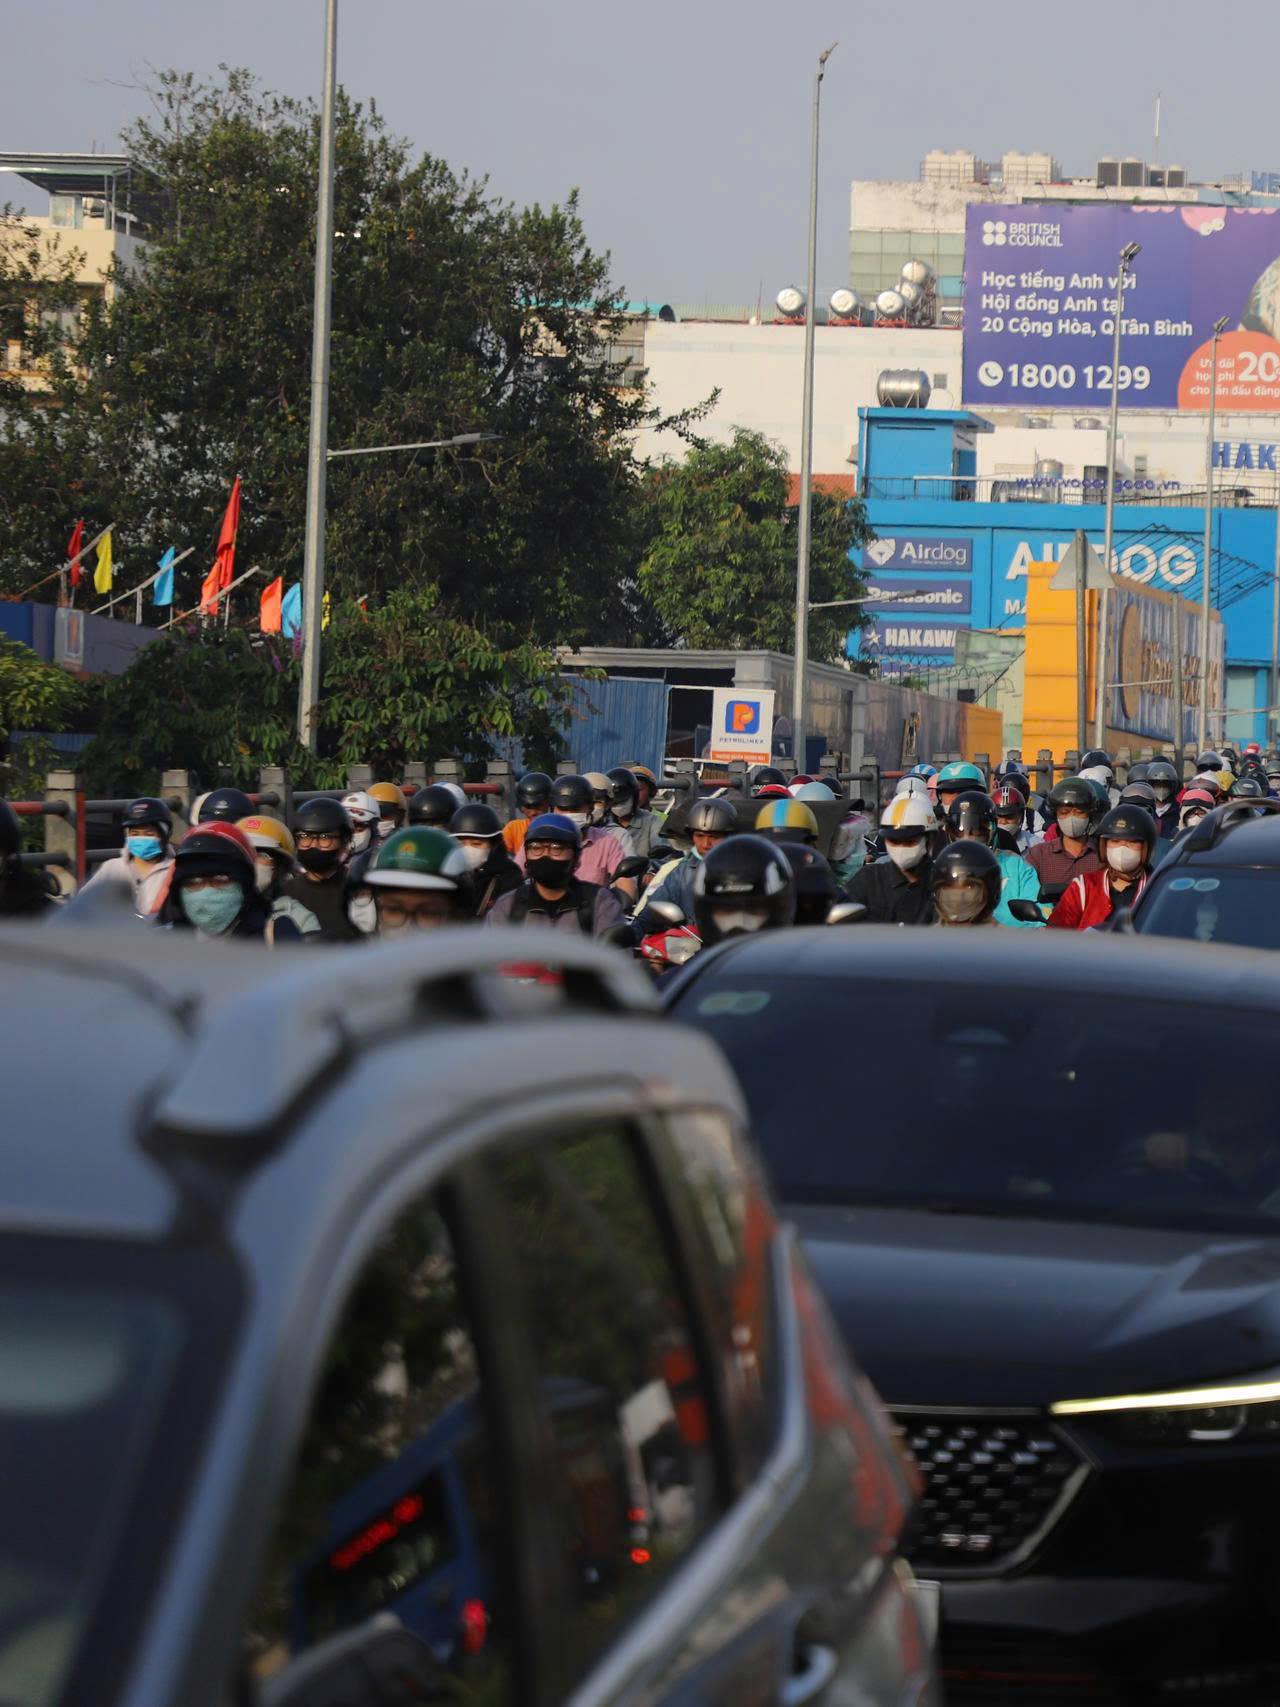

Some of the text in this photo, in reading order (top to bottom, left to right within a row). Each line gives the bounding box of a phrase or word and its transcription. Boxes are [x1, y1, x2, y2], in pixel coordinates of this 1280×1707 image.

[1009, 223, 1061, 235] BRITISH
[1008, 234, 1063, 247] COUNCIL
[981, 271, 1016, 290] Học
[1020, 269, 1065, 292] tiếng
[1068, 273, 1103, 289] Anh
[981, 294, 1010, 313] Hội
[1063, 296, 1098, 312] Anh
[981, 317, 1004, 333] 20
[1008, 317, 1053, 337] Cộng
[1057, 318, 1097, 337] Hòa,
[1154, 318, 1193, 336] Bình
[1007, 363, 1152, 390] 1800 1299
[900, 541, 967, 566] Airdog
[885, 628, 957, 648] HAKAW
